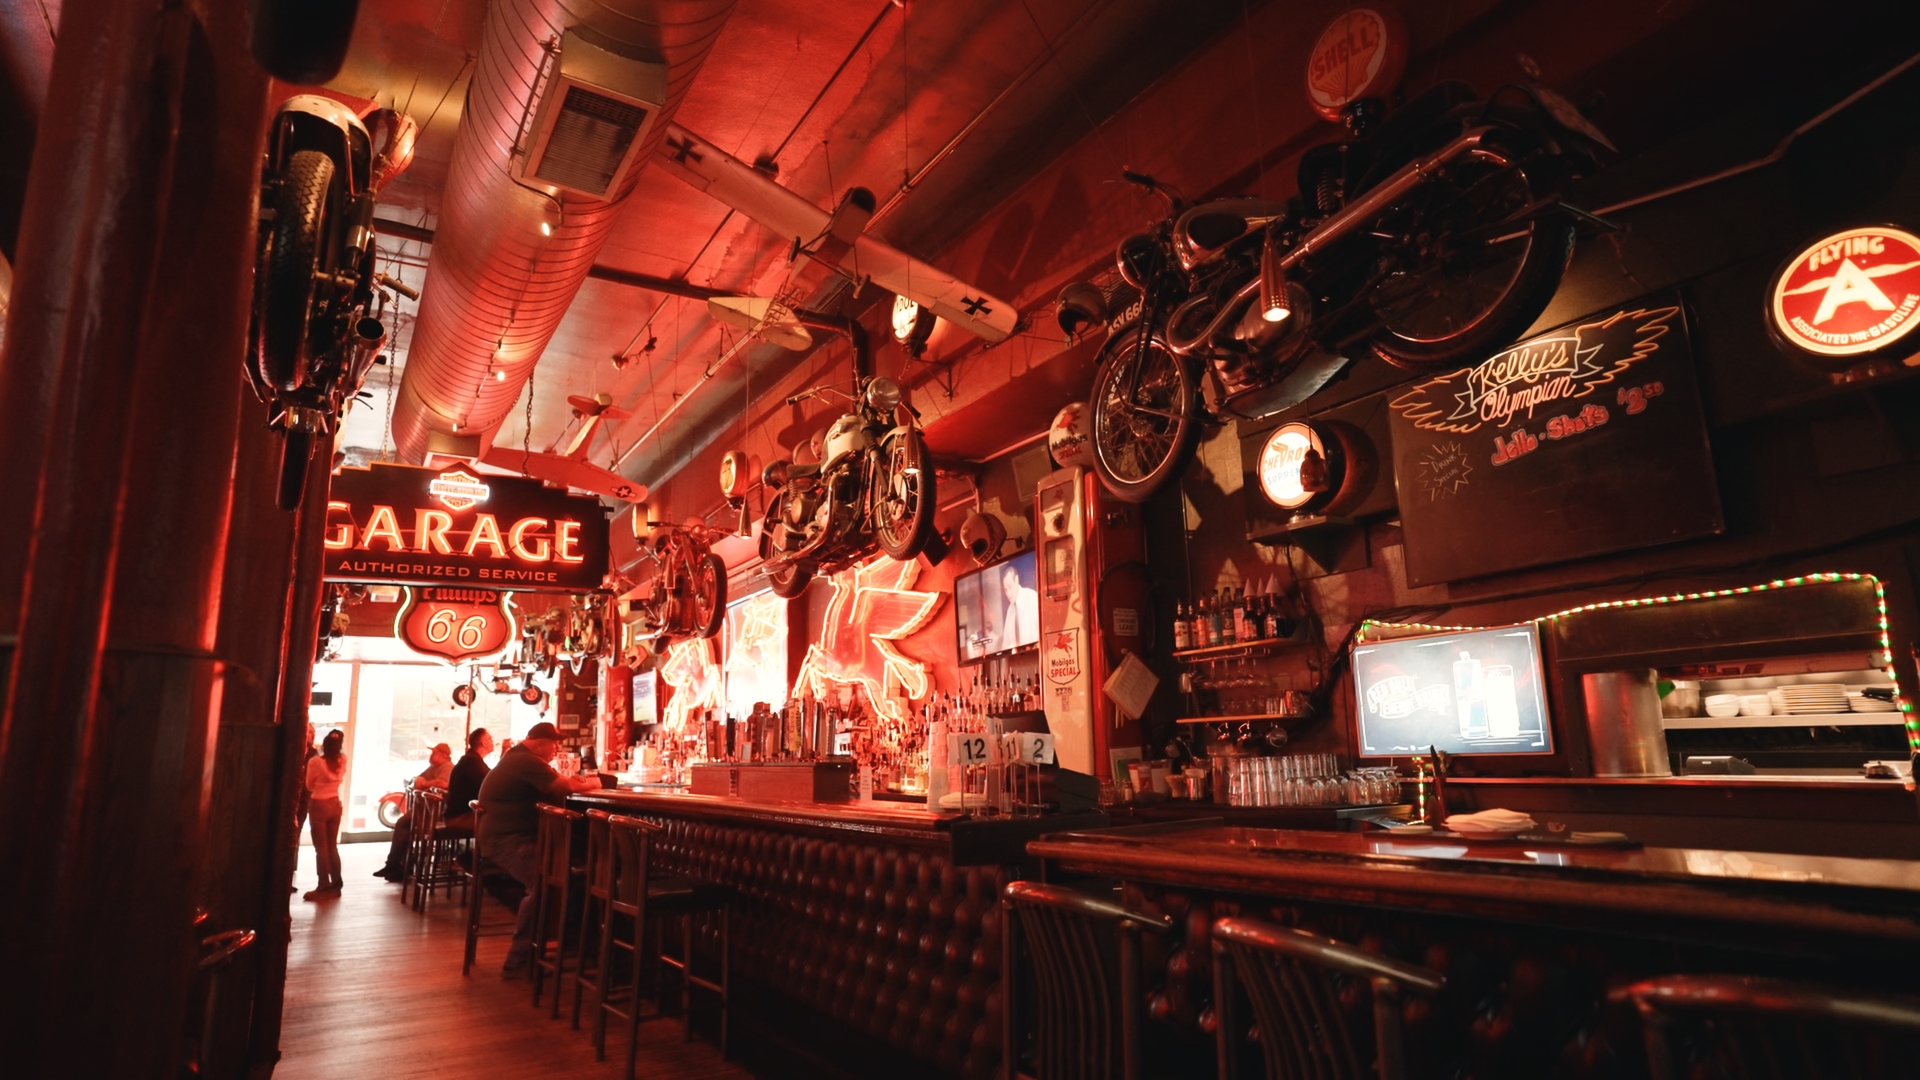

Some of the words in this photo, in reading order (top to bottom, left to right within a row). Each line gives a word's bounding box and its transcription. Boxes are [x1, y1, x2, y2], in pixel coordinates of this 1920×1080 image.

[1313, 26, 1375, 81] SHELL
[1809, 236, 1885, 272] FLYING
[1812, 257, 1897, 326] A
[1790, 316, 1849, 344] ASSOCIATED
[1868, 293, 1920, 337] GASOLINE
[1473, 342, 1569, 394] Kelly's
[1481, 373, 1577, 427] Olympian
[1491, 428, 1538, 466] Jello
[324, 500, 585, 565] GARAGE
[338, 560, 471, 577] AUTHORIZED
[478, 567, 558, 582] SERVICE
[427, 608, 487, 650] 66
[1050, 667, 1077, 678] SPECIAL
[1051, 658, 1076, 668] Mobilgas
[963, 738, 987, 760] 12
[1006, 737, 1017, 760] 11
[1033, 738, 1045, 759] 2
